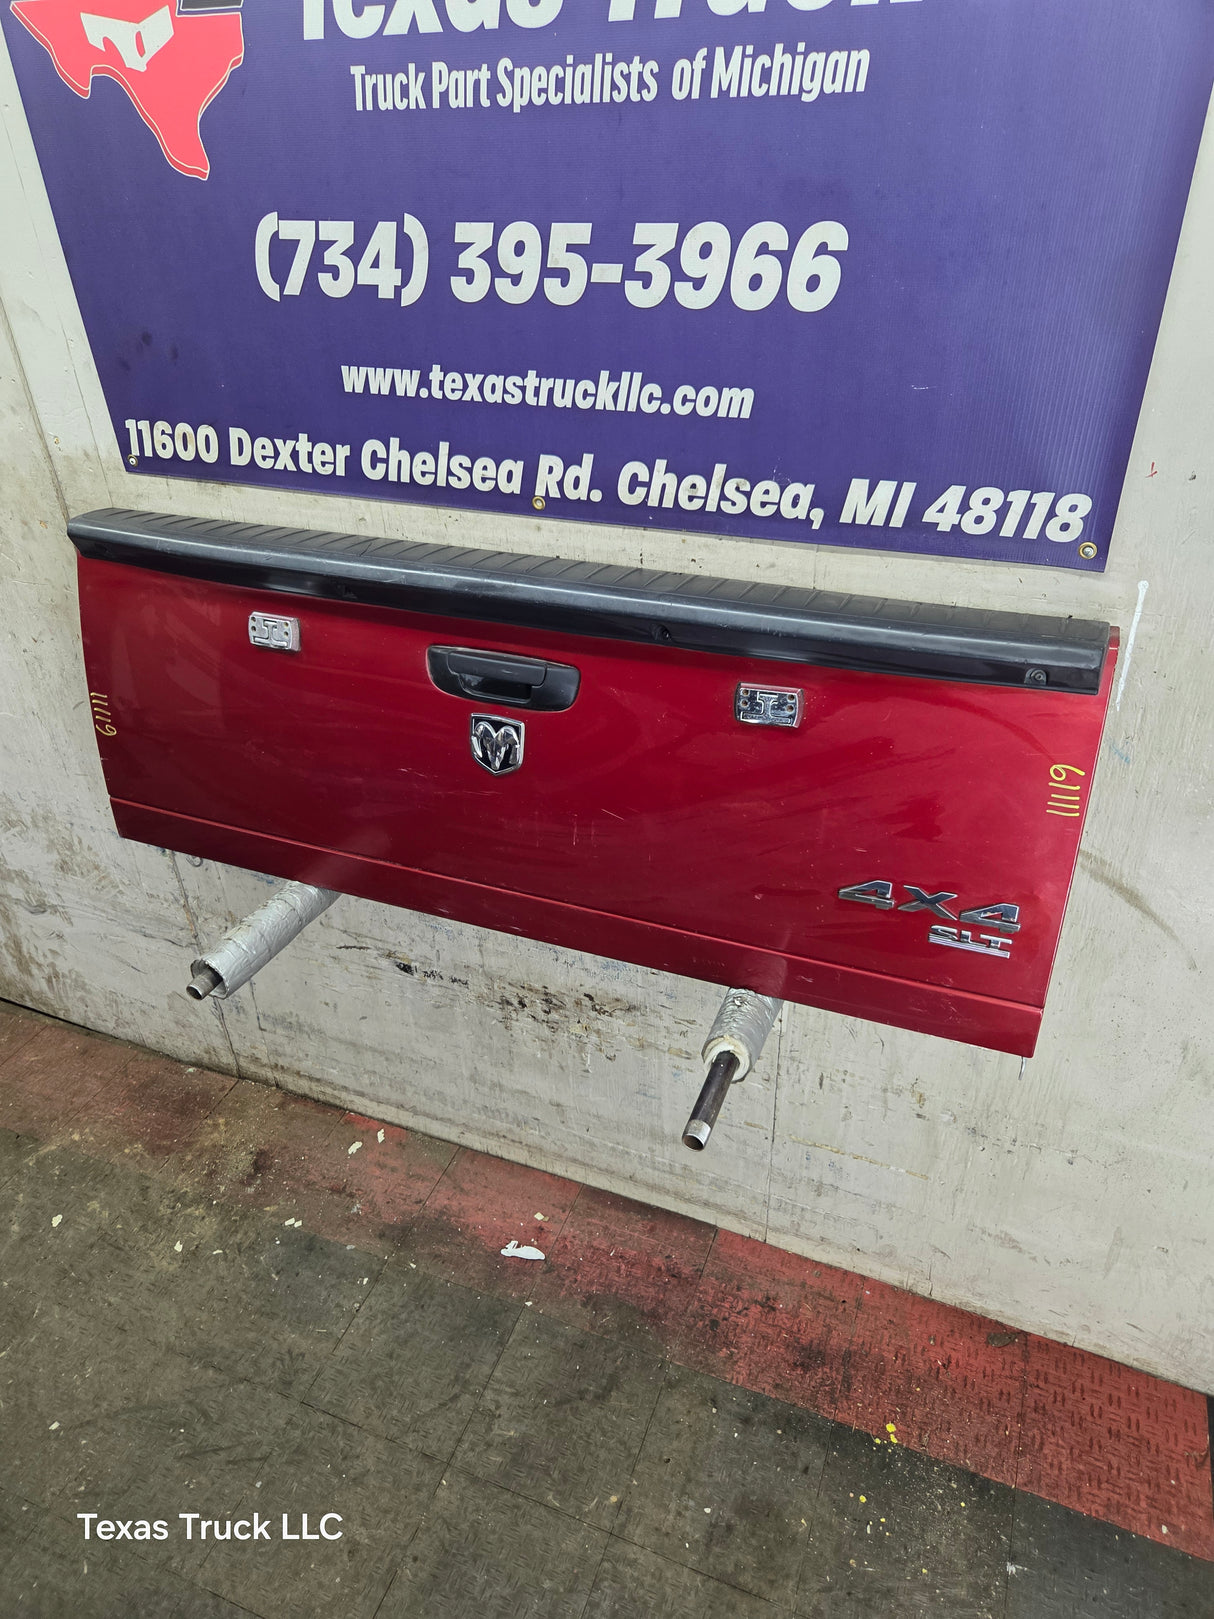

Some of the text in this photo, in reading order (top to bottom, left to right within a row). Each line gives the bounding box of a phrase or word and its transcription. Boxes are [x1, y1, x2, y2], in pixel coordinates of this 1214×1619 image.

[350, 42, 870, 113] Truck Part Specialists of Michigan
[254, 212, 849, 313] (734) 395-3966
[341, 364, 755, 419] www.texastruckllc.com
[125, 418, 1093, 543] 11600 Dexter Chelsea Rd. Chelsea, MI 48118
[929, 924, 1013, 957] SLT
